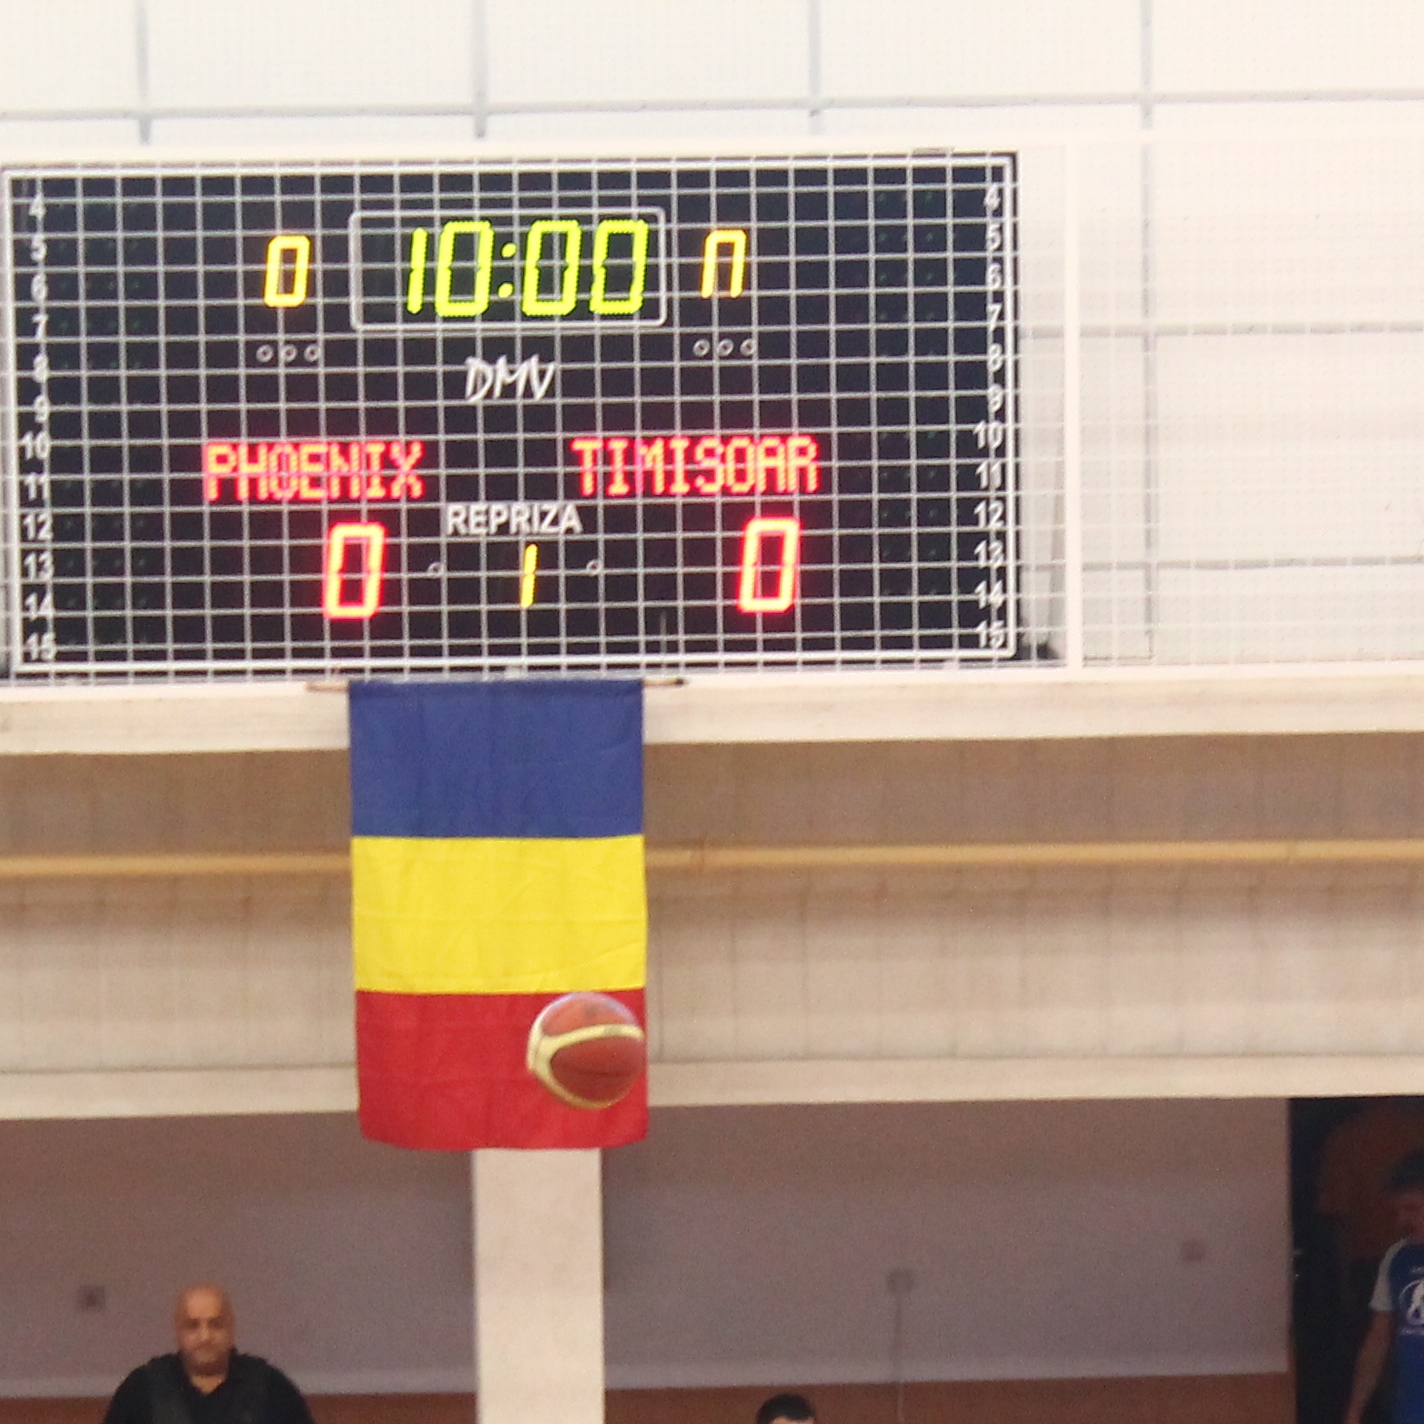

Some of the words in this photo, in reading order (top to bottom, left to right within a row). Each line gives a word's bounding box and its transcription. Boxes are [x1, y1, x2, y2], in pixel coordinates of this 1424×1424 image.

[29, 194, 46, 218] 4
[984, 183, 1000, 211] 4
[30, 235, 47, 261] 5
[985, 224, 1001, 250] 5
[263, 235, 310, 307] 0
[407, 220, 648, 316] 10:00
[986, 262, 1002, 289] 6
[31, 272, 47, 300] 6
[32, 314, 48, 339] 7
[987, 304, 1002, 331] 7
[33, 353, 49, 382] 8
[987, 342, 1003, 372] 8
[465, 354, 554, 401] DMV
[34, 394, 50, 423] 9
[988, 383, 1004, 413] 9
[21, 431, 51, 460] 10
[973, 420, 1003, 449] 10
[203, 440, 423, 501] PHOENIX
[571, 435, 819, 495] TIMISOAR
[976, 461, 1003, 489] 11
[24, 472, 50, 500] 11
[23, 513, 53, 540] 12
[446, 503, 584, 535] REPRIZA
[974, 501, 1004, 529] 12
[24, 552, 54, 580] 13
[738, 516, 801, 613] 0
[974, 540, 1004, 569] 13
[324, 522, 386, 619] 0
[520, 543, 538, 608] 1
[25, 592, 54, 621] 14
[974, 580, 1004, 609] 14
[26, 633, 56, 661] 15
[976, 620, 1005, 648] 15
